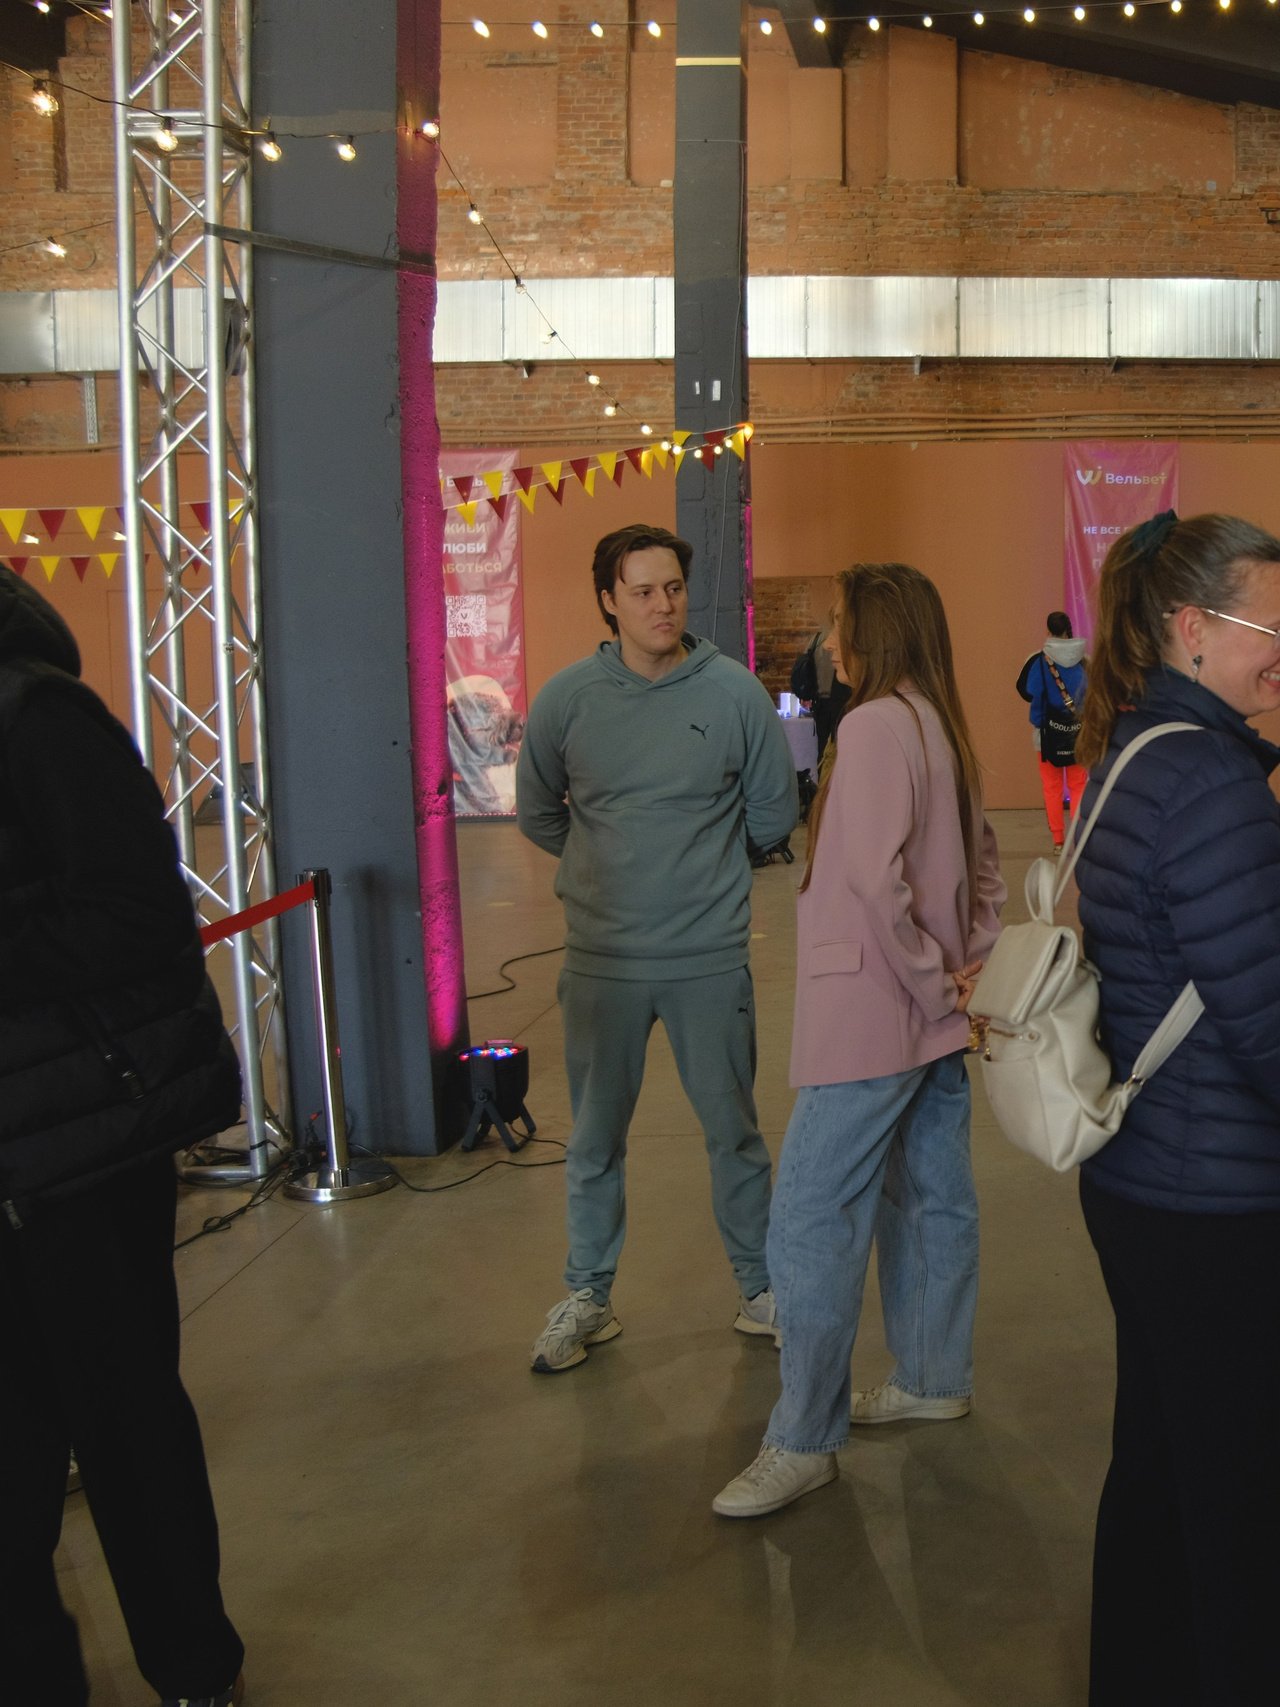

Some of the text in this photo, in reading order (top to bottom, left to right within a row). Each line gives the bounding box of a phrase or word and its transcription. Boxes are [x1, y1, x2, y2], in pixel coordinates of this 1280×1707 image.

[1105, 472, 1167, 484] Вельвет
[1083, 526, 1098, 535] НЕ
[1100, 526, 1121, 535] ВСЕ
[442, 542, 487, 554] ЛЮБИ
[442, 562, 503, 574] БОТЬСЯ
